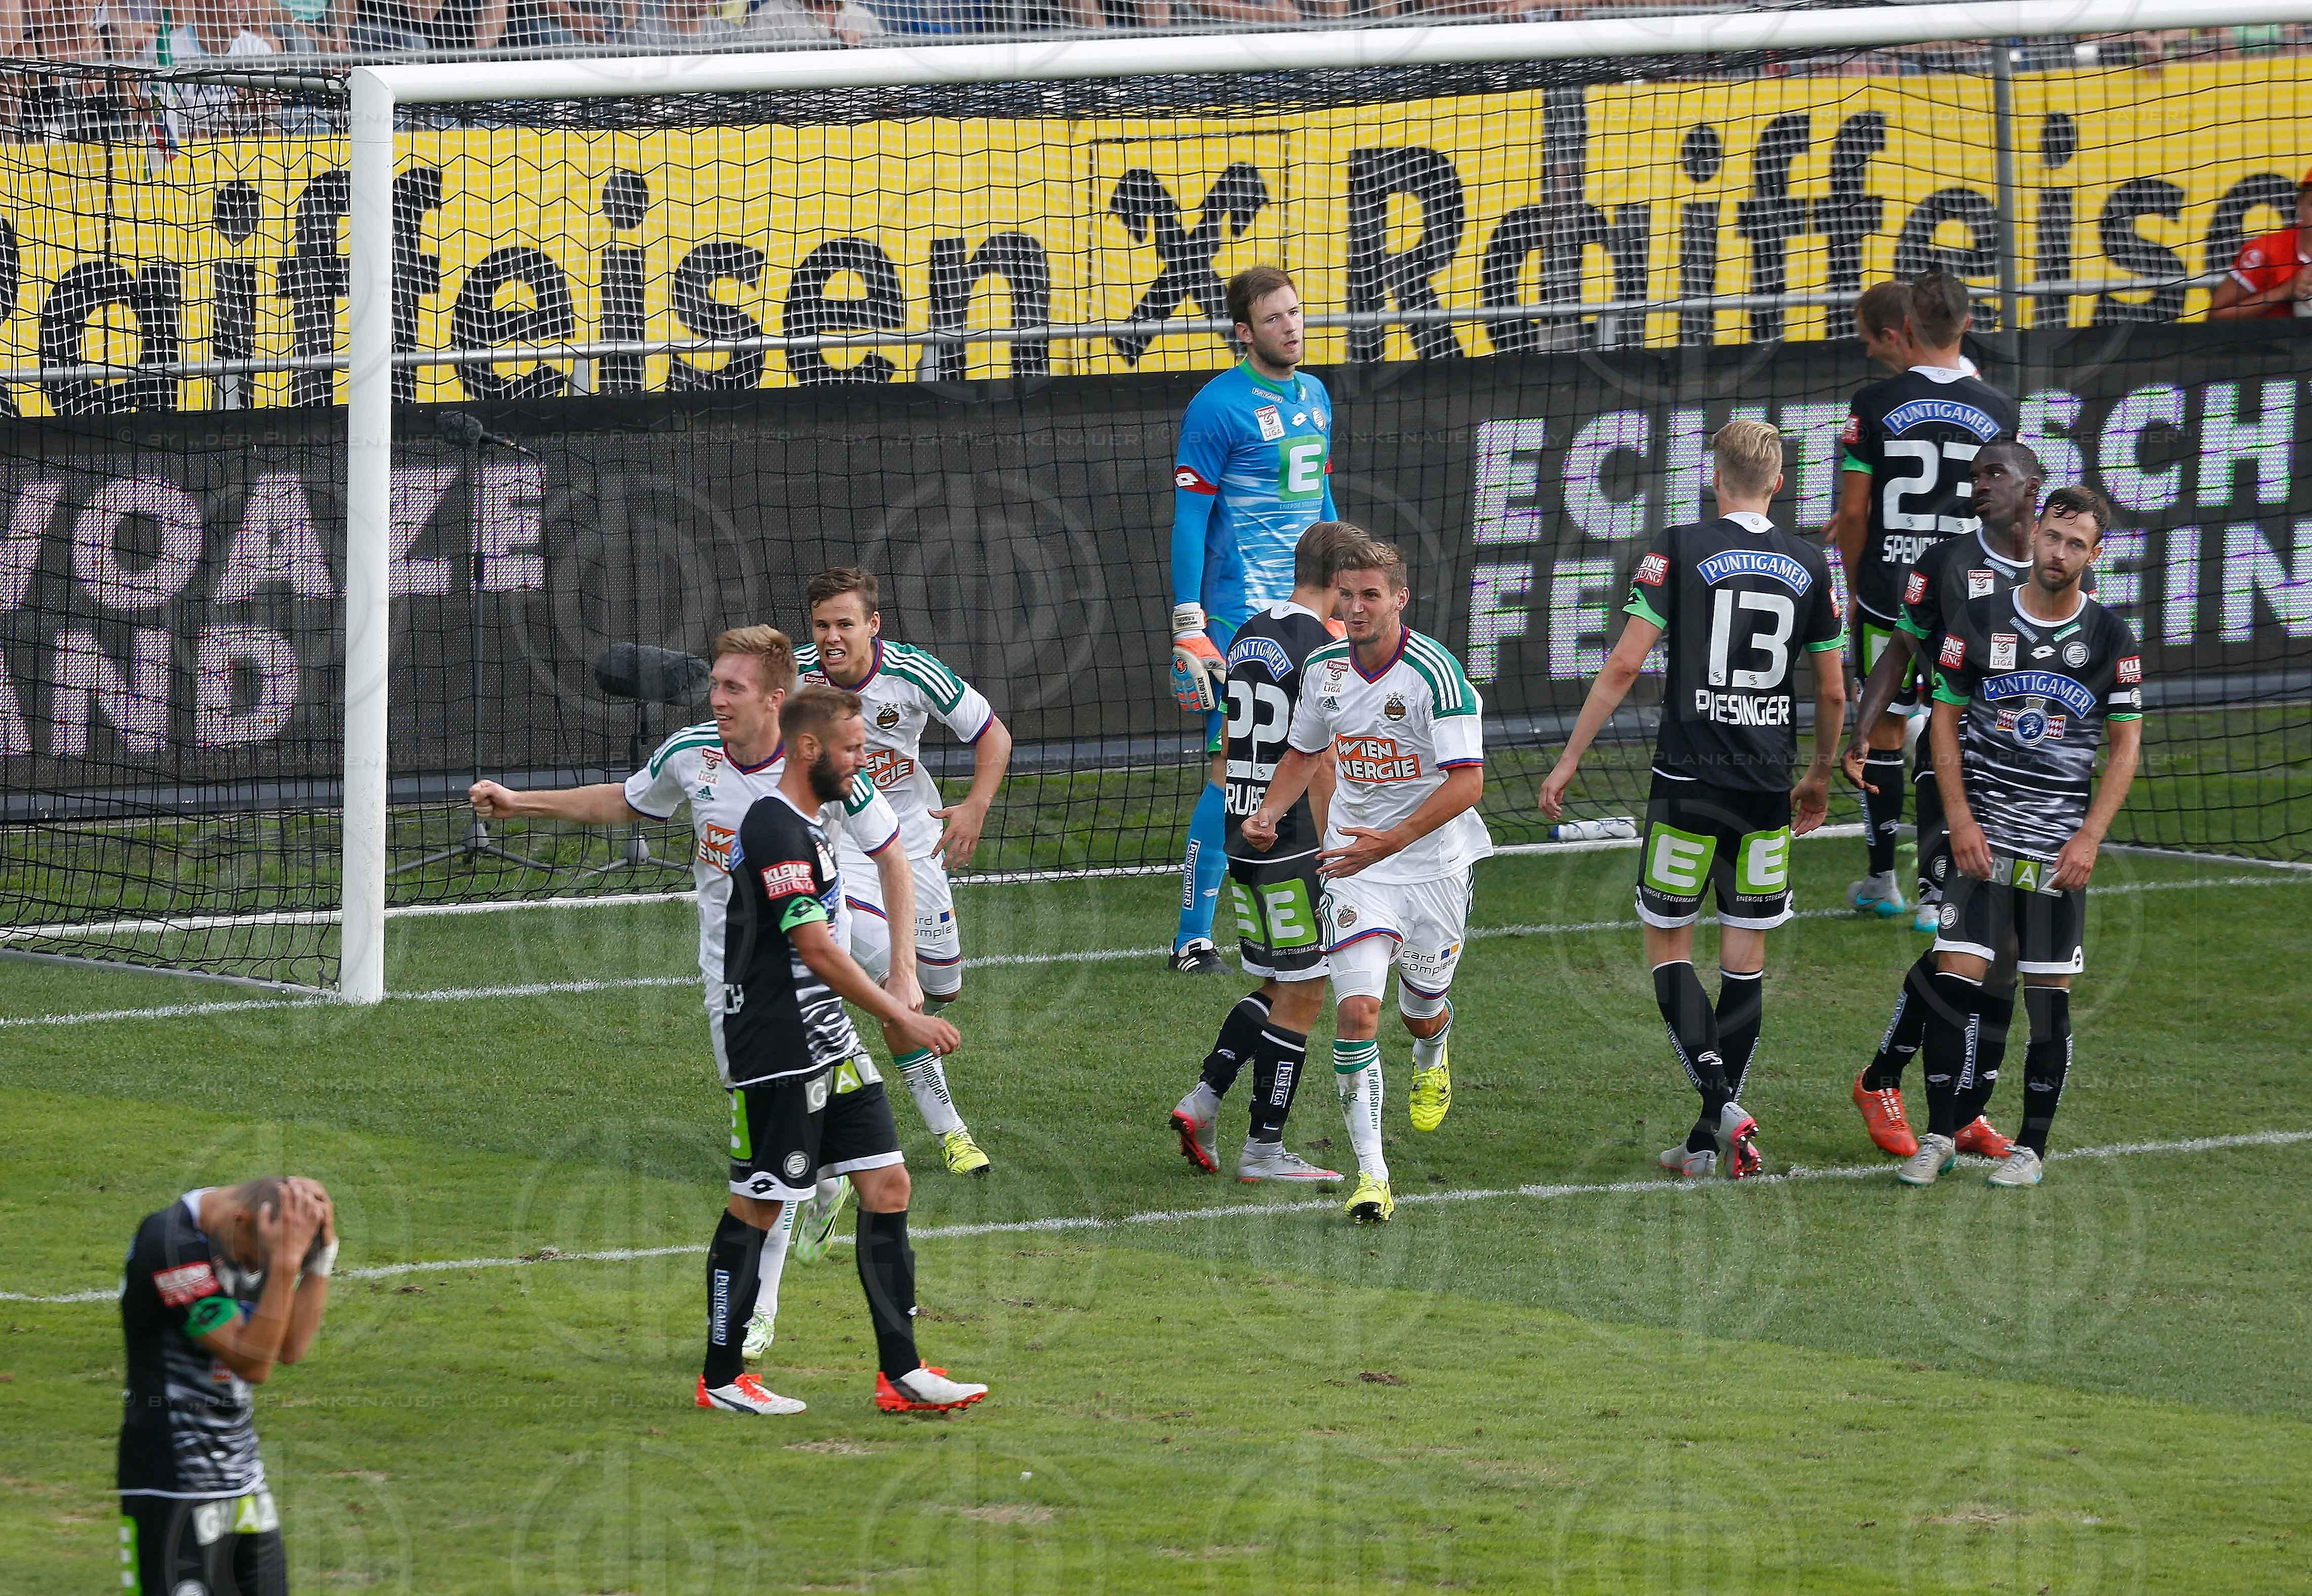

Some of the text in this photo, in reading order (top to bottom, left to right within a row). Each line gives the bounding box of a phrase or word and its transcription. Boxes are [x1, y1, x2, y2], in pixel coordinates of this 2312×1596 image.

[0, 167, 1050, 414] aiffeisen
[1889, 403, 1991, 438] PUNTIGAMER
[1288, 444, 1321, 493] E
[1706, 554, 1806, 591] PUNTIGAMER
[1708, 589, 1795, 689] 13
[1228, 640, 1286, 676] PUNTIGAMER
[1328, 661, 1348, 671] tipico
[1695, 688, 1791, 727] PIESINGER
[1986, 675, 2089, 713] PUNTIGAMER
[1337, 739, 1393, 760] WIEN
[1340, 758, 1416, 780] NERGIE
[763, 864, 811, 881] KLEINE
[1652, 834, 1705, 888] E
[1747, 835, 1786, 885] E
[1989, 858, 2061, 893] RAZ
[768, 877, 815, 895] ZEITUNG
[1266, 890, 1305, 939] E
[1400, 956, 1456, 977] complete
[1403, 950, 1435, 963] card
[1272, 1066, 1292, 1106] PUNTIGA
[1366, 1068, 1380, 1130] RAPIDSHOP.AT
